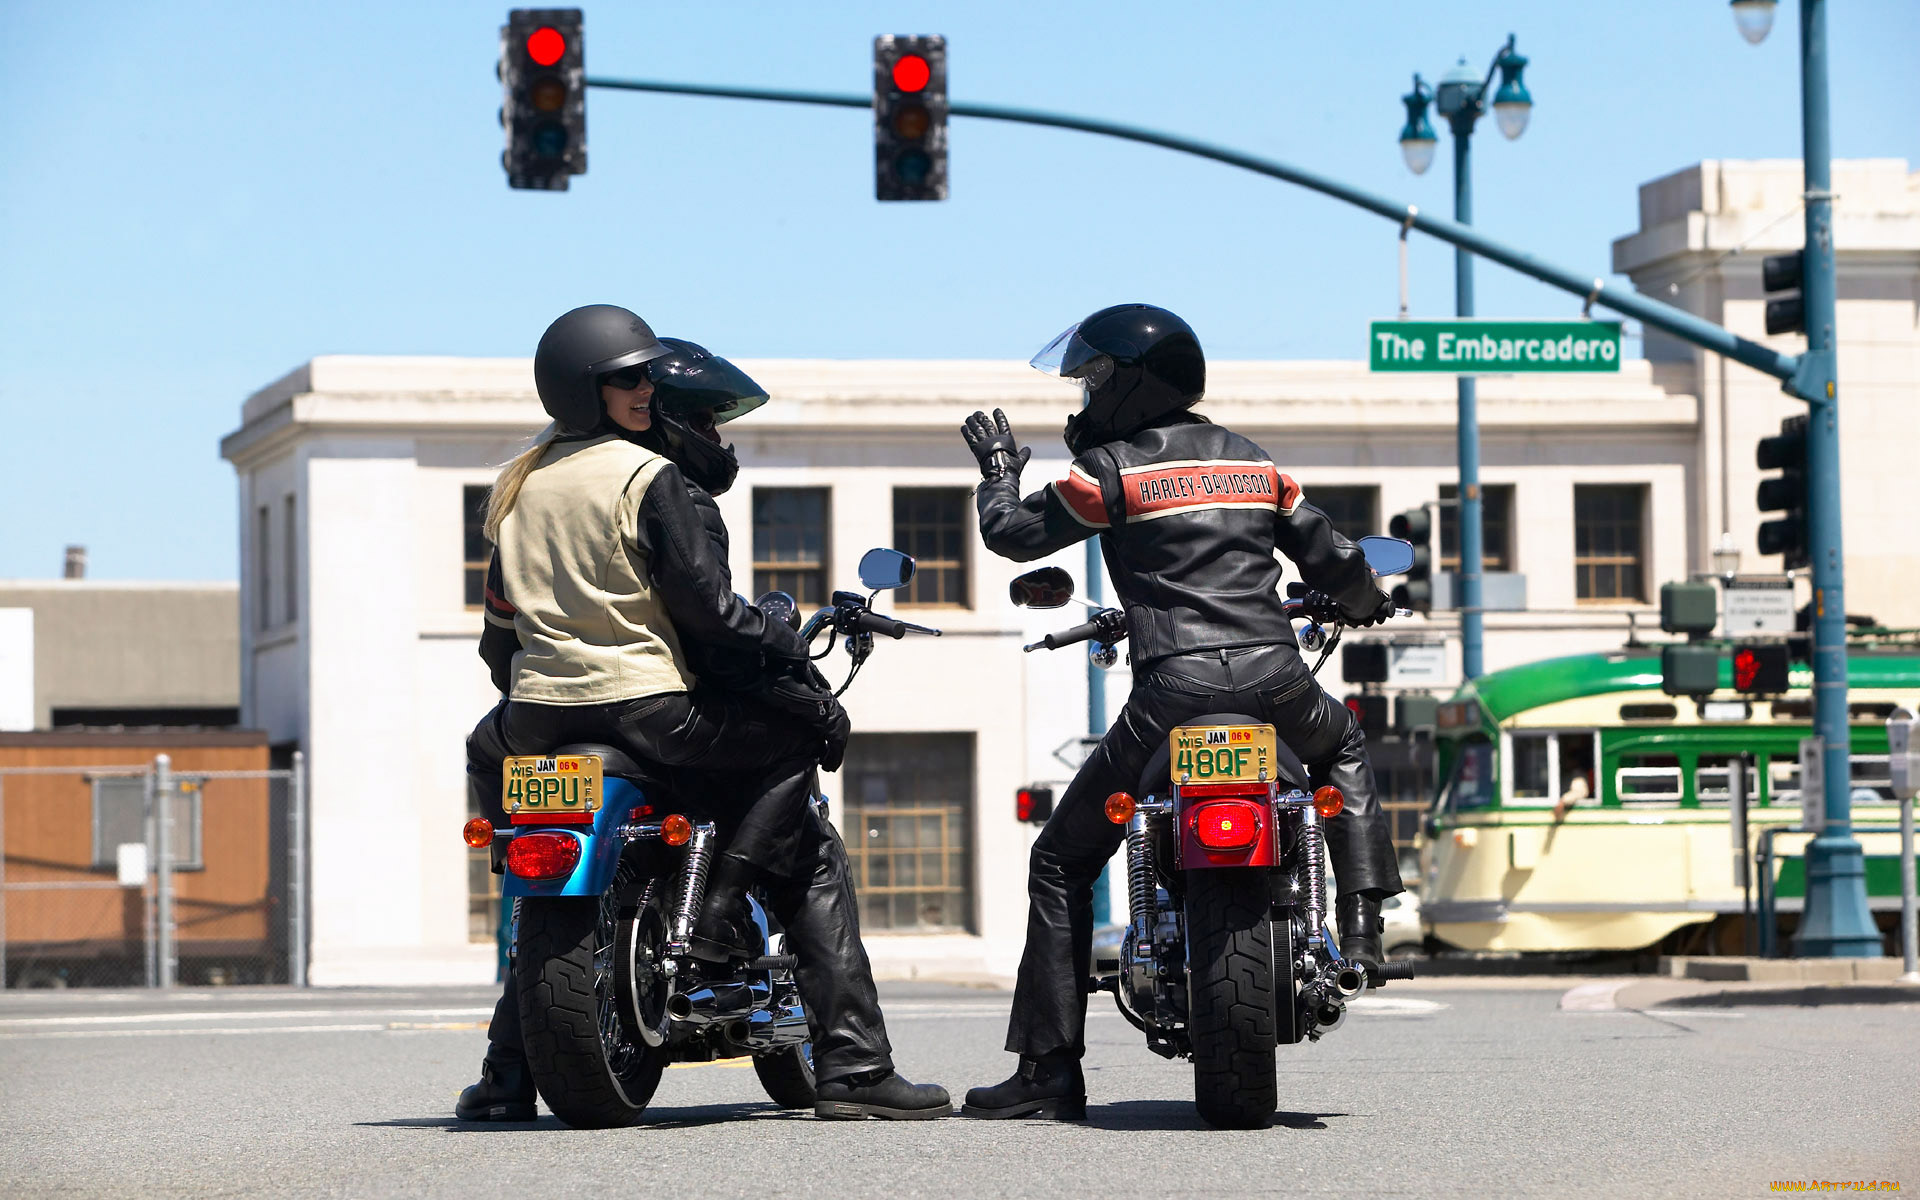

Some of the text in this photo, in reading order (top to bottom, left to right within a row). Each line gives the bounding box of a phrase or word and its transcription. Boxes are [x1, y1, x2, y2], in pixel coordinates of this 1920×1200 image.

[1377, 332, 1617, 361] The Embarcadero
[1139, 473, 1273, 504] HARLEY-DAVIDSON
[1178, 737, 1203, 748] WIS
[1207, 732, 1242, 744] JAN 06
[511, 766, 534, 778] WIS
[537, 759, 570, 772] JAN 06
[1176, 747, 1252, 778] 48QF
[507, 777, 580, 808] 48PU
